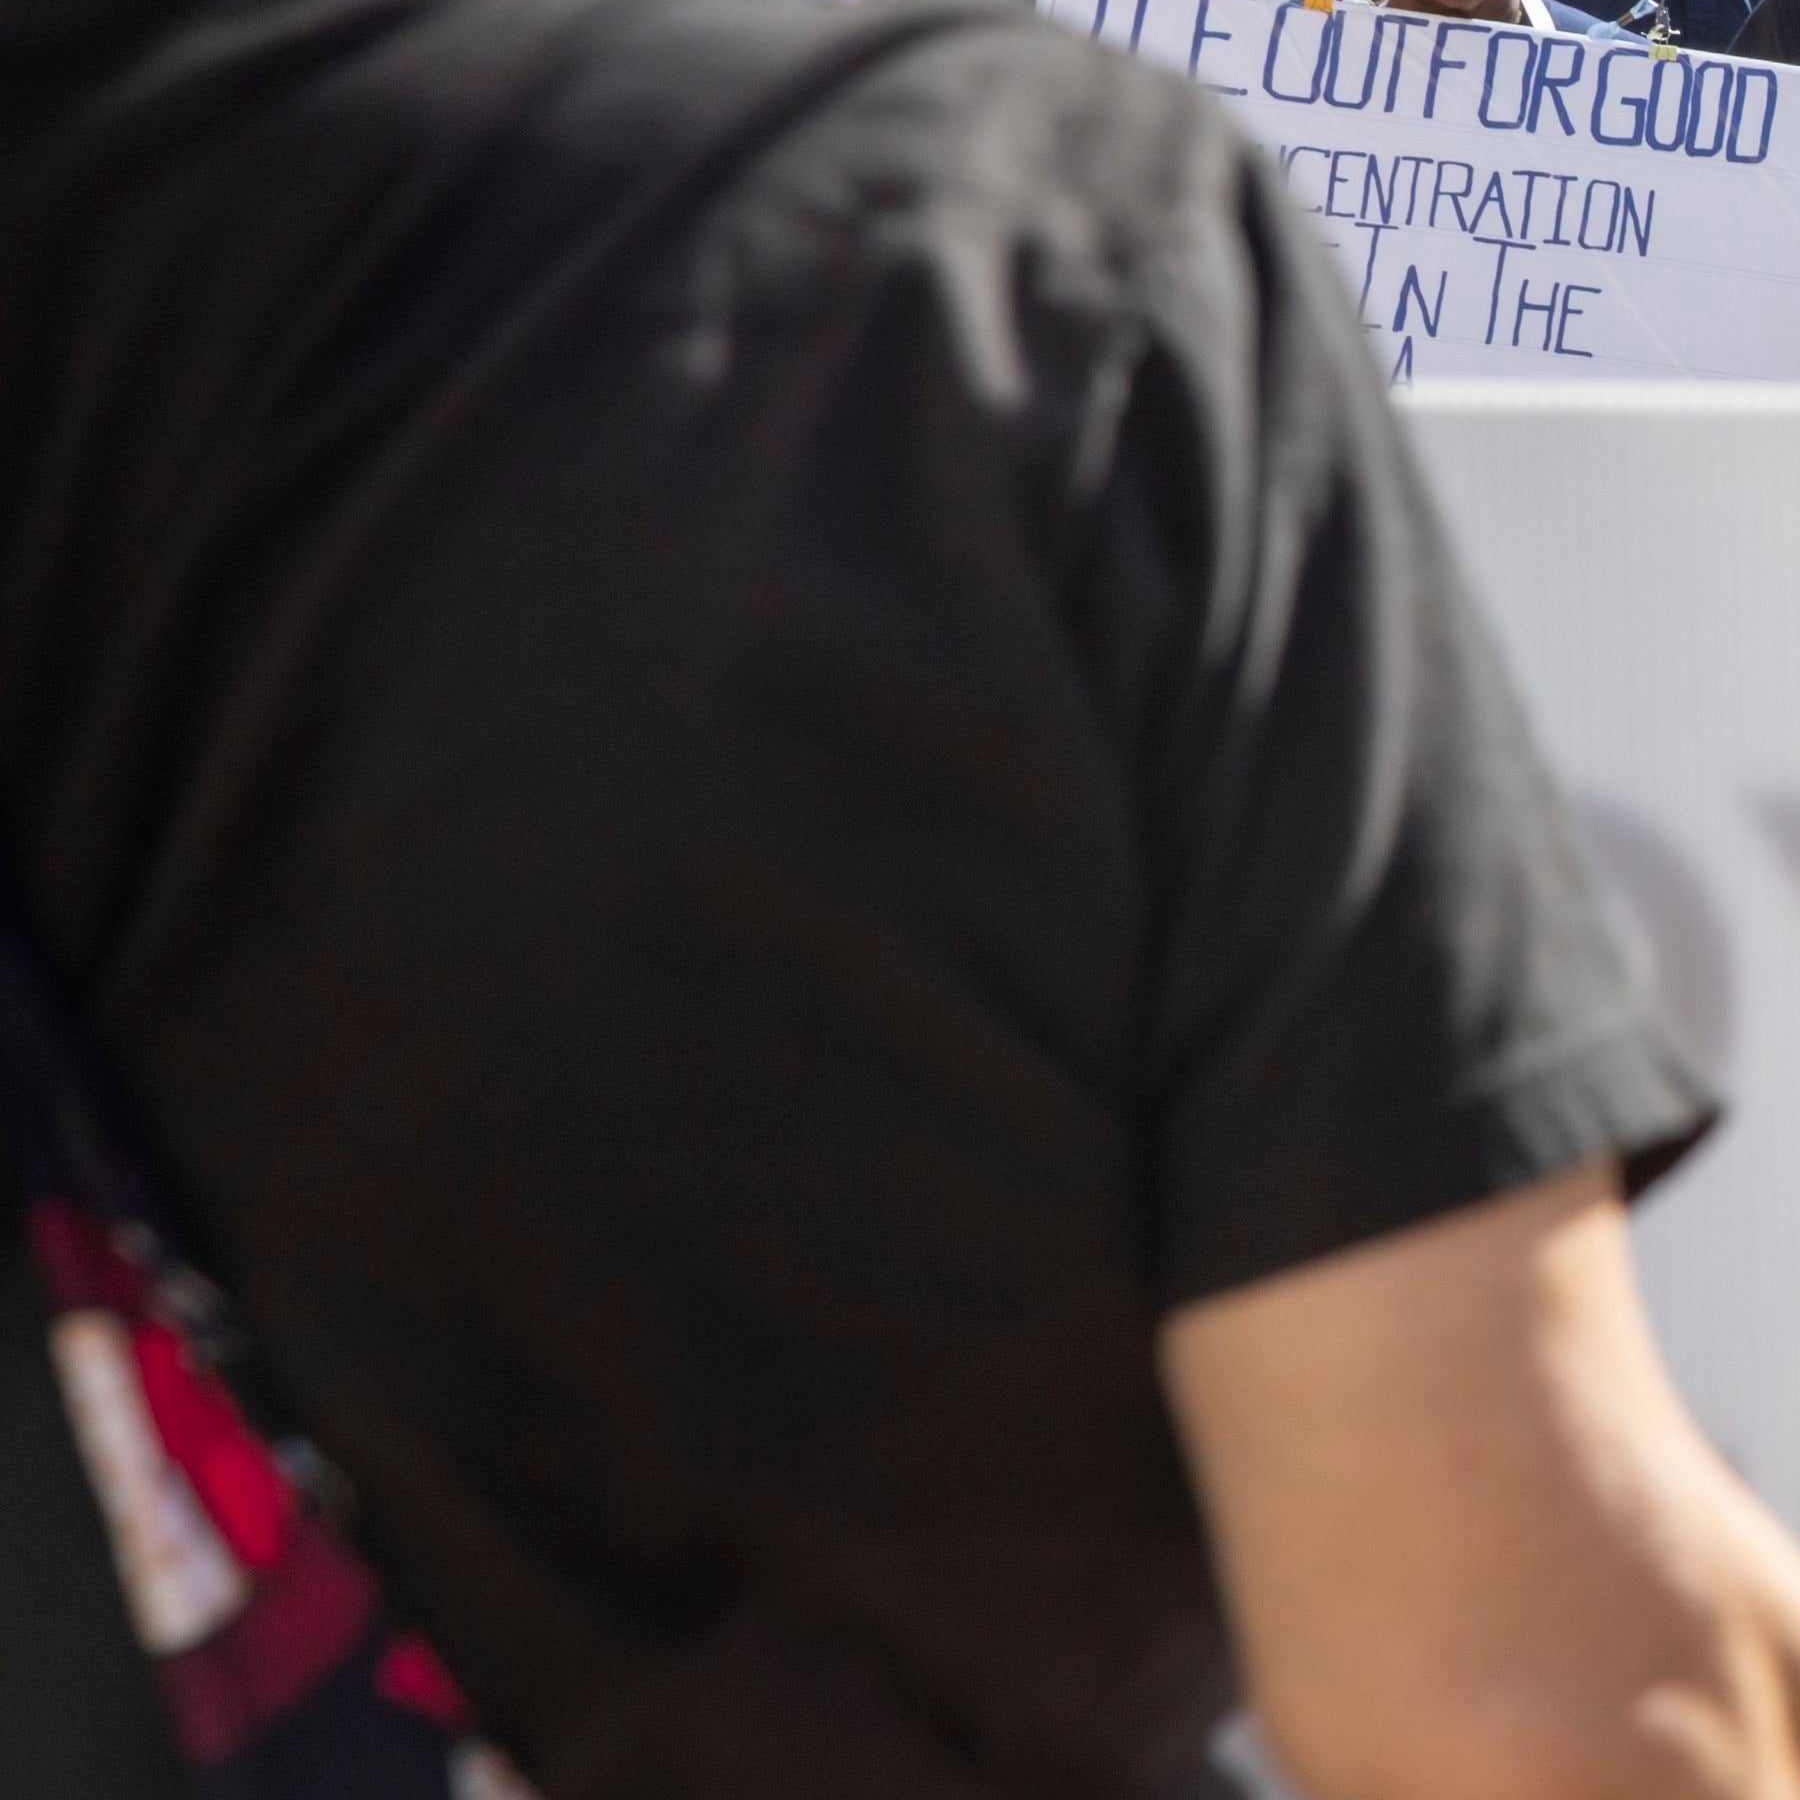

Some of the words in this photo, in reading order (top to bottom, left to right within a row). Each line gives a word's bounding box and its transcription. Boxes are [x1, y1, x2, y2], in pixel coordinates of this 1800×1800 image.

[1422, 19, 1586, 137] FOR
[1590, 46, 1778, 165] GOOD
[1279, 144, 1655, 257] CENTRATION
[1472, 235, 1603, 358] THE
